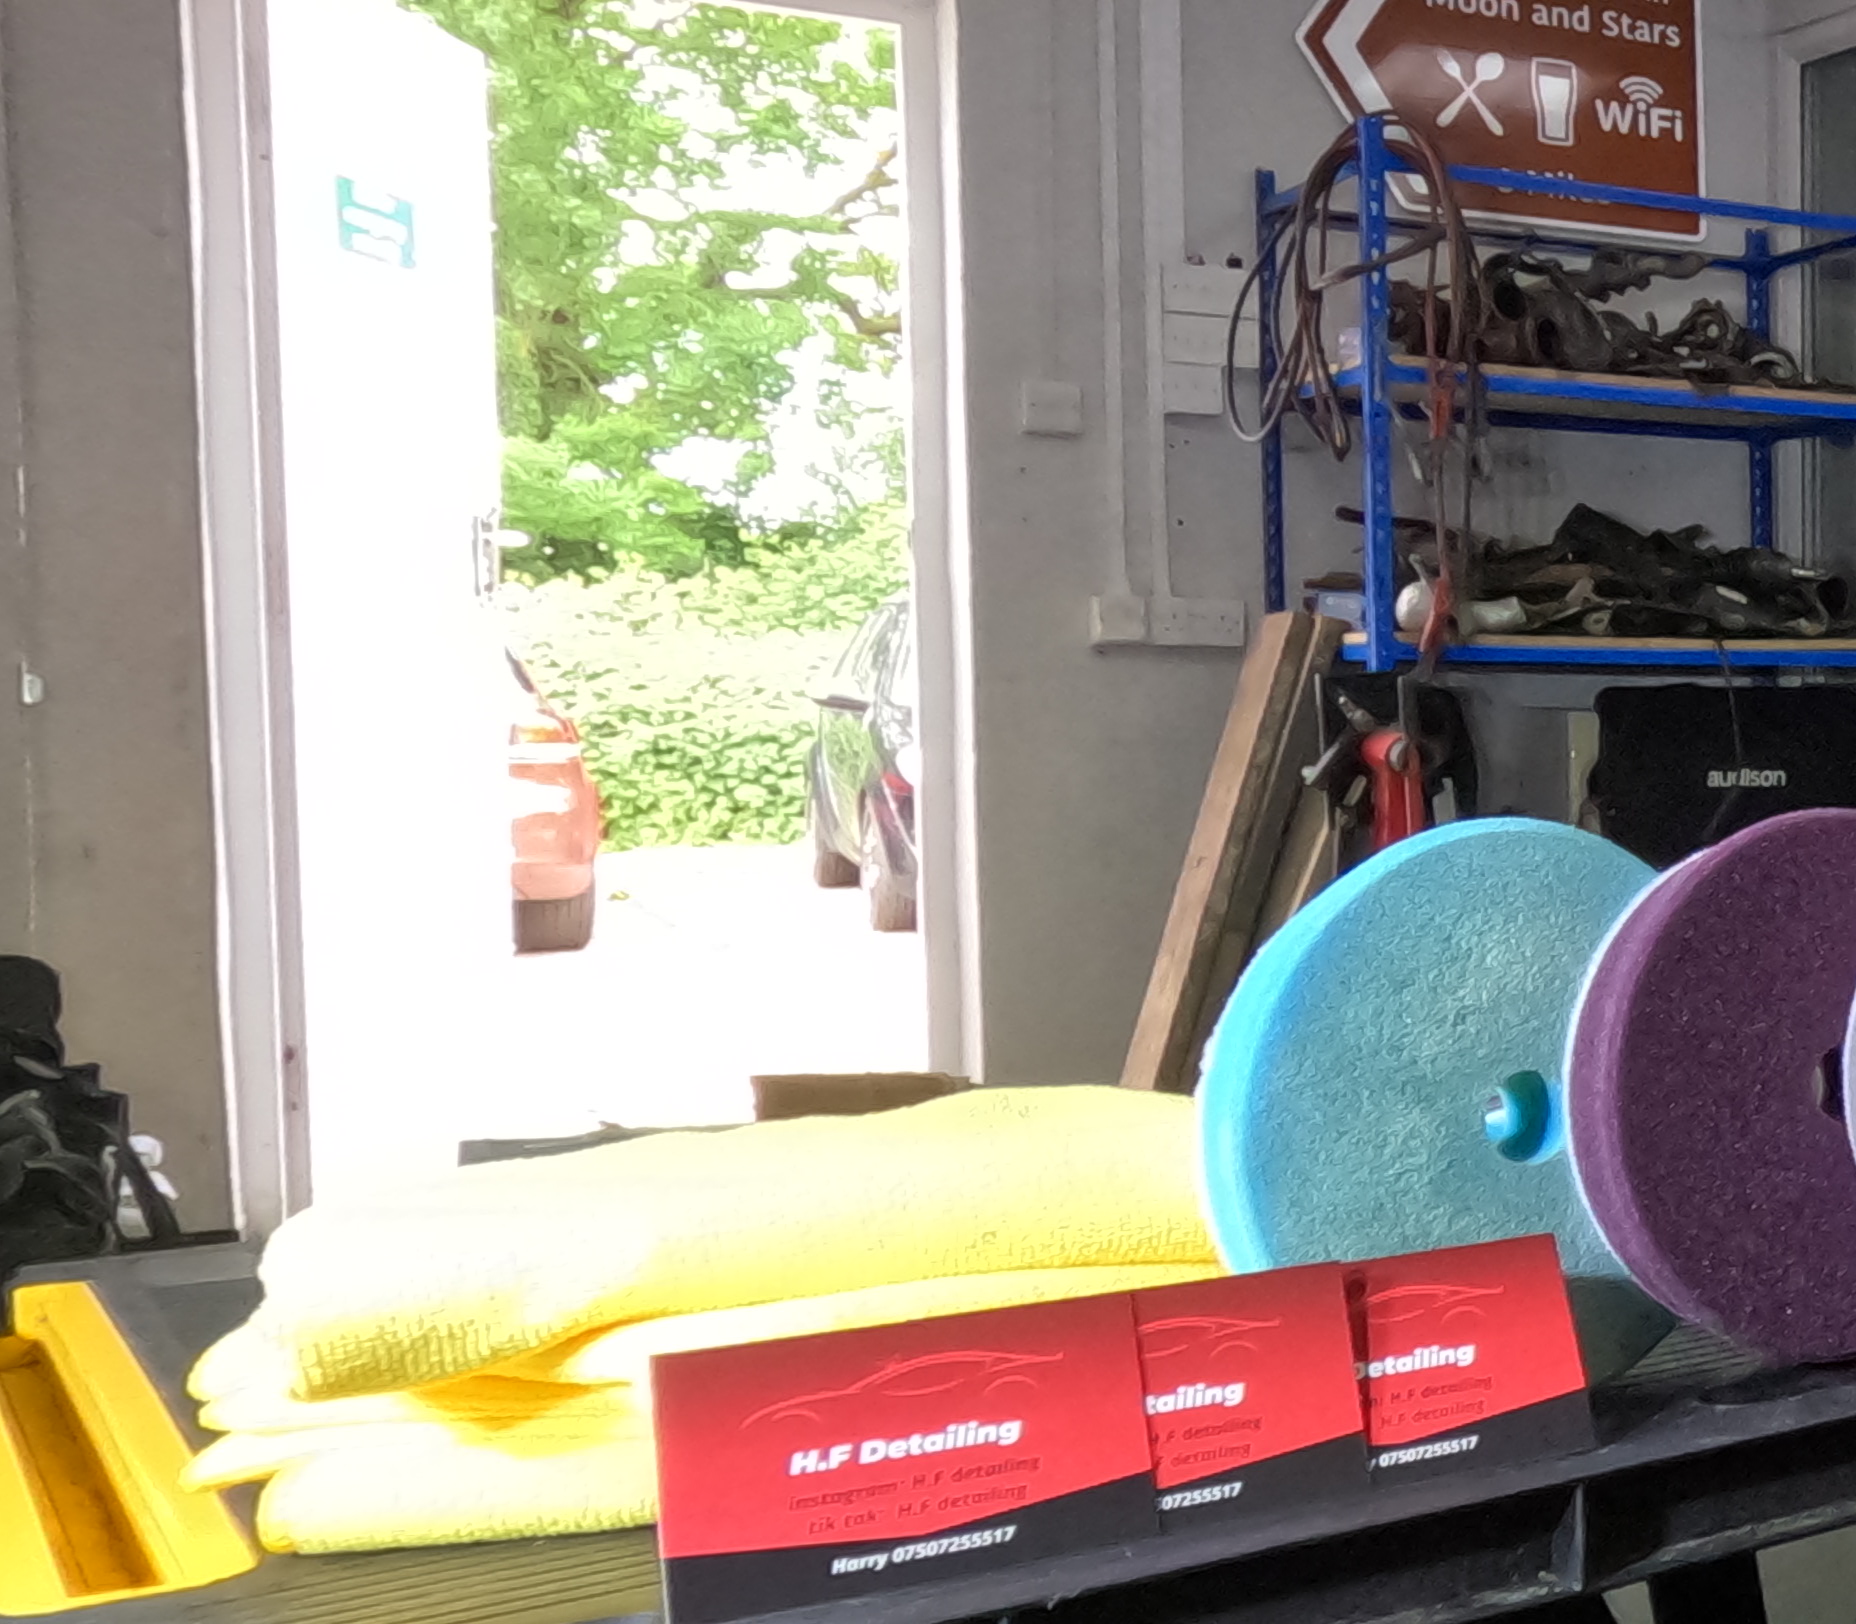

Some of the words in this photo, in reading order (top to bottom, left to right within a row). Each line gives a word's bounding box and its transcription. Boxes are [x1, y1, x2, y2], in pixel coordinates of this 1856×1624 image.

[1531, 1, 1592, 34] and
[1601, 10, 1682, 48] Stars
[1594, 97, 1684, 143] WiFi
[788, 1444, 853, 1476] H.F
[858, 1420, 1024, 1464] Detailing
[830, 1551, 890, 1577] Harry
[890, 1524, 1018, 1565] 07507255517
